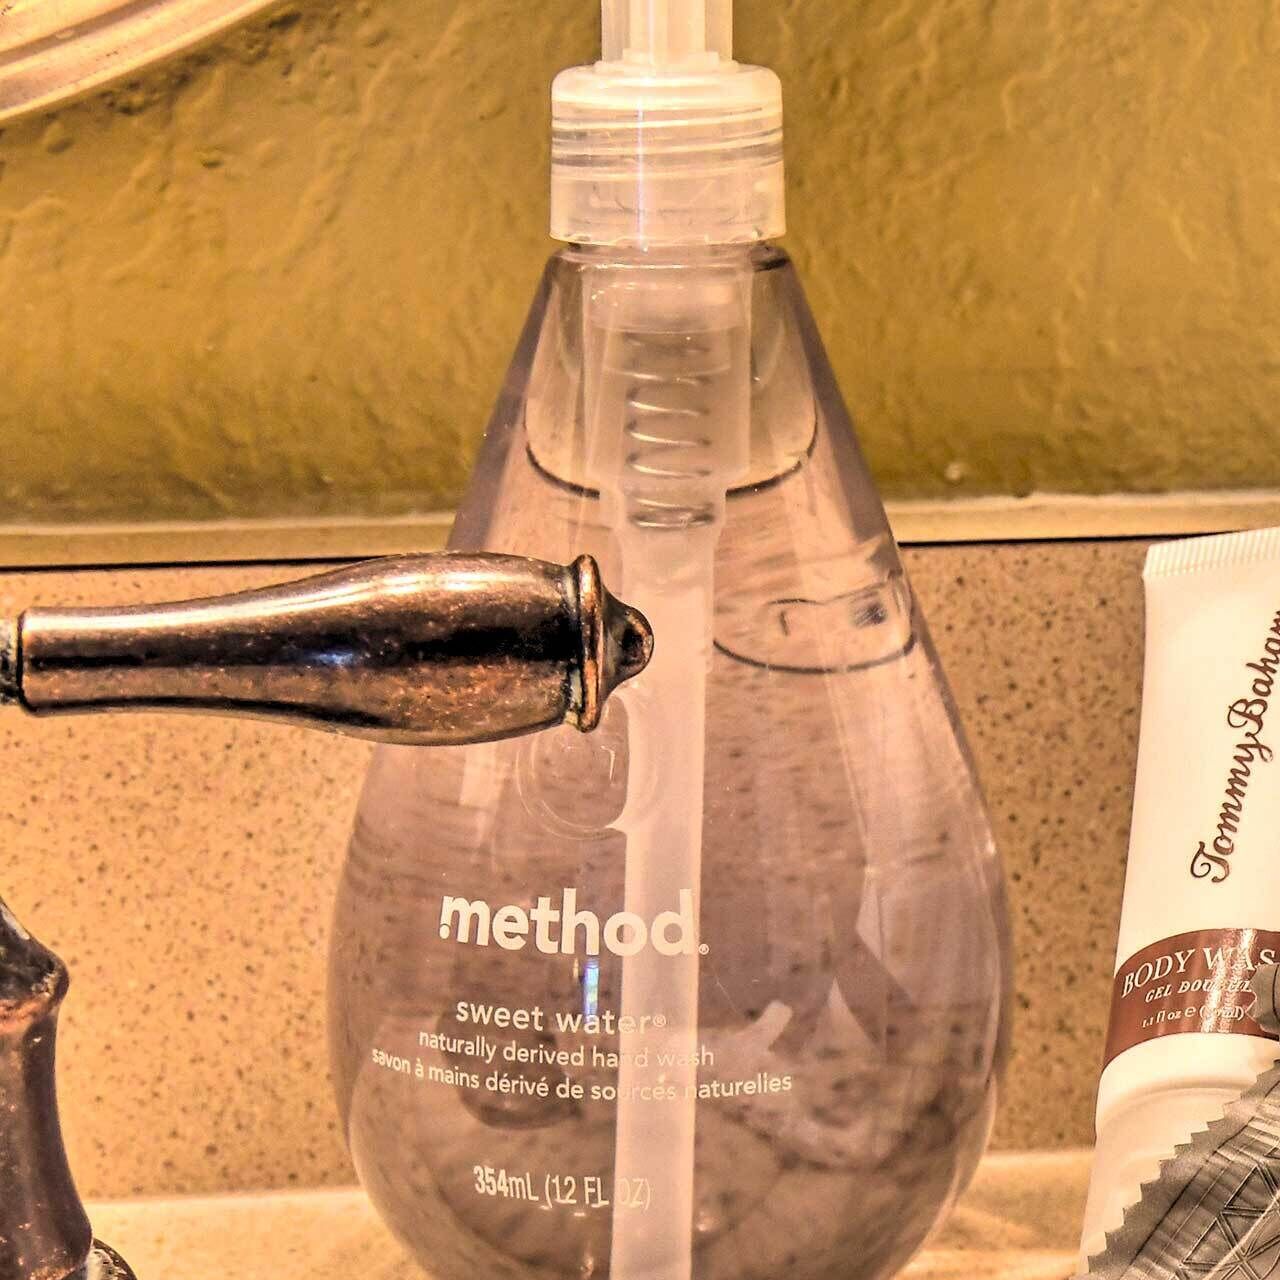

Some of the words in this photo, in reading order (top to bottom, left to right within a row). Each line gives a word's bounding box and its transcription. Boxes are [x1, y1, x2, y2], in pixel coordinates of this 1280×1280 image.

[1121, 948, 1196, 998] BODY
[1144, 983, 1173, 1003] GEL
[455, 1001, 543, 1031] sweet
[1167, 1010, 1182, 1021] oz
[418, 1031, 497, 1064] naturally
[502, 1040, 584, 1067] derived
[371, 1048, 411, 1075] savon
[415, 1058, 425, 1078] à
[428, 1066, 480, 1089] mains
[485, 1071, 549, 1098] dérivé
[555, 1078, 584, 1100] de
[473, 1165, 540, 1201] 354mL
[544, 1173, 578, 1209] (12
[584, 1176, 610, 1208] FL
